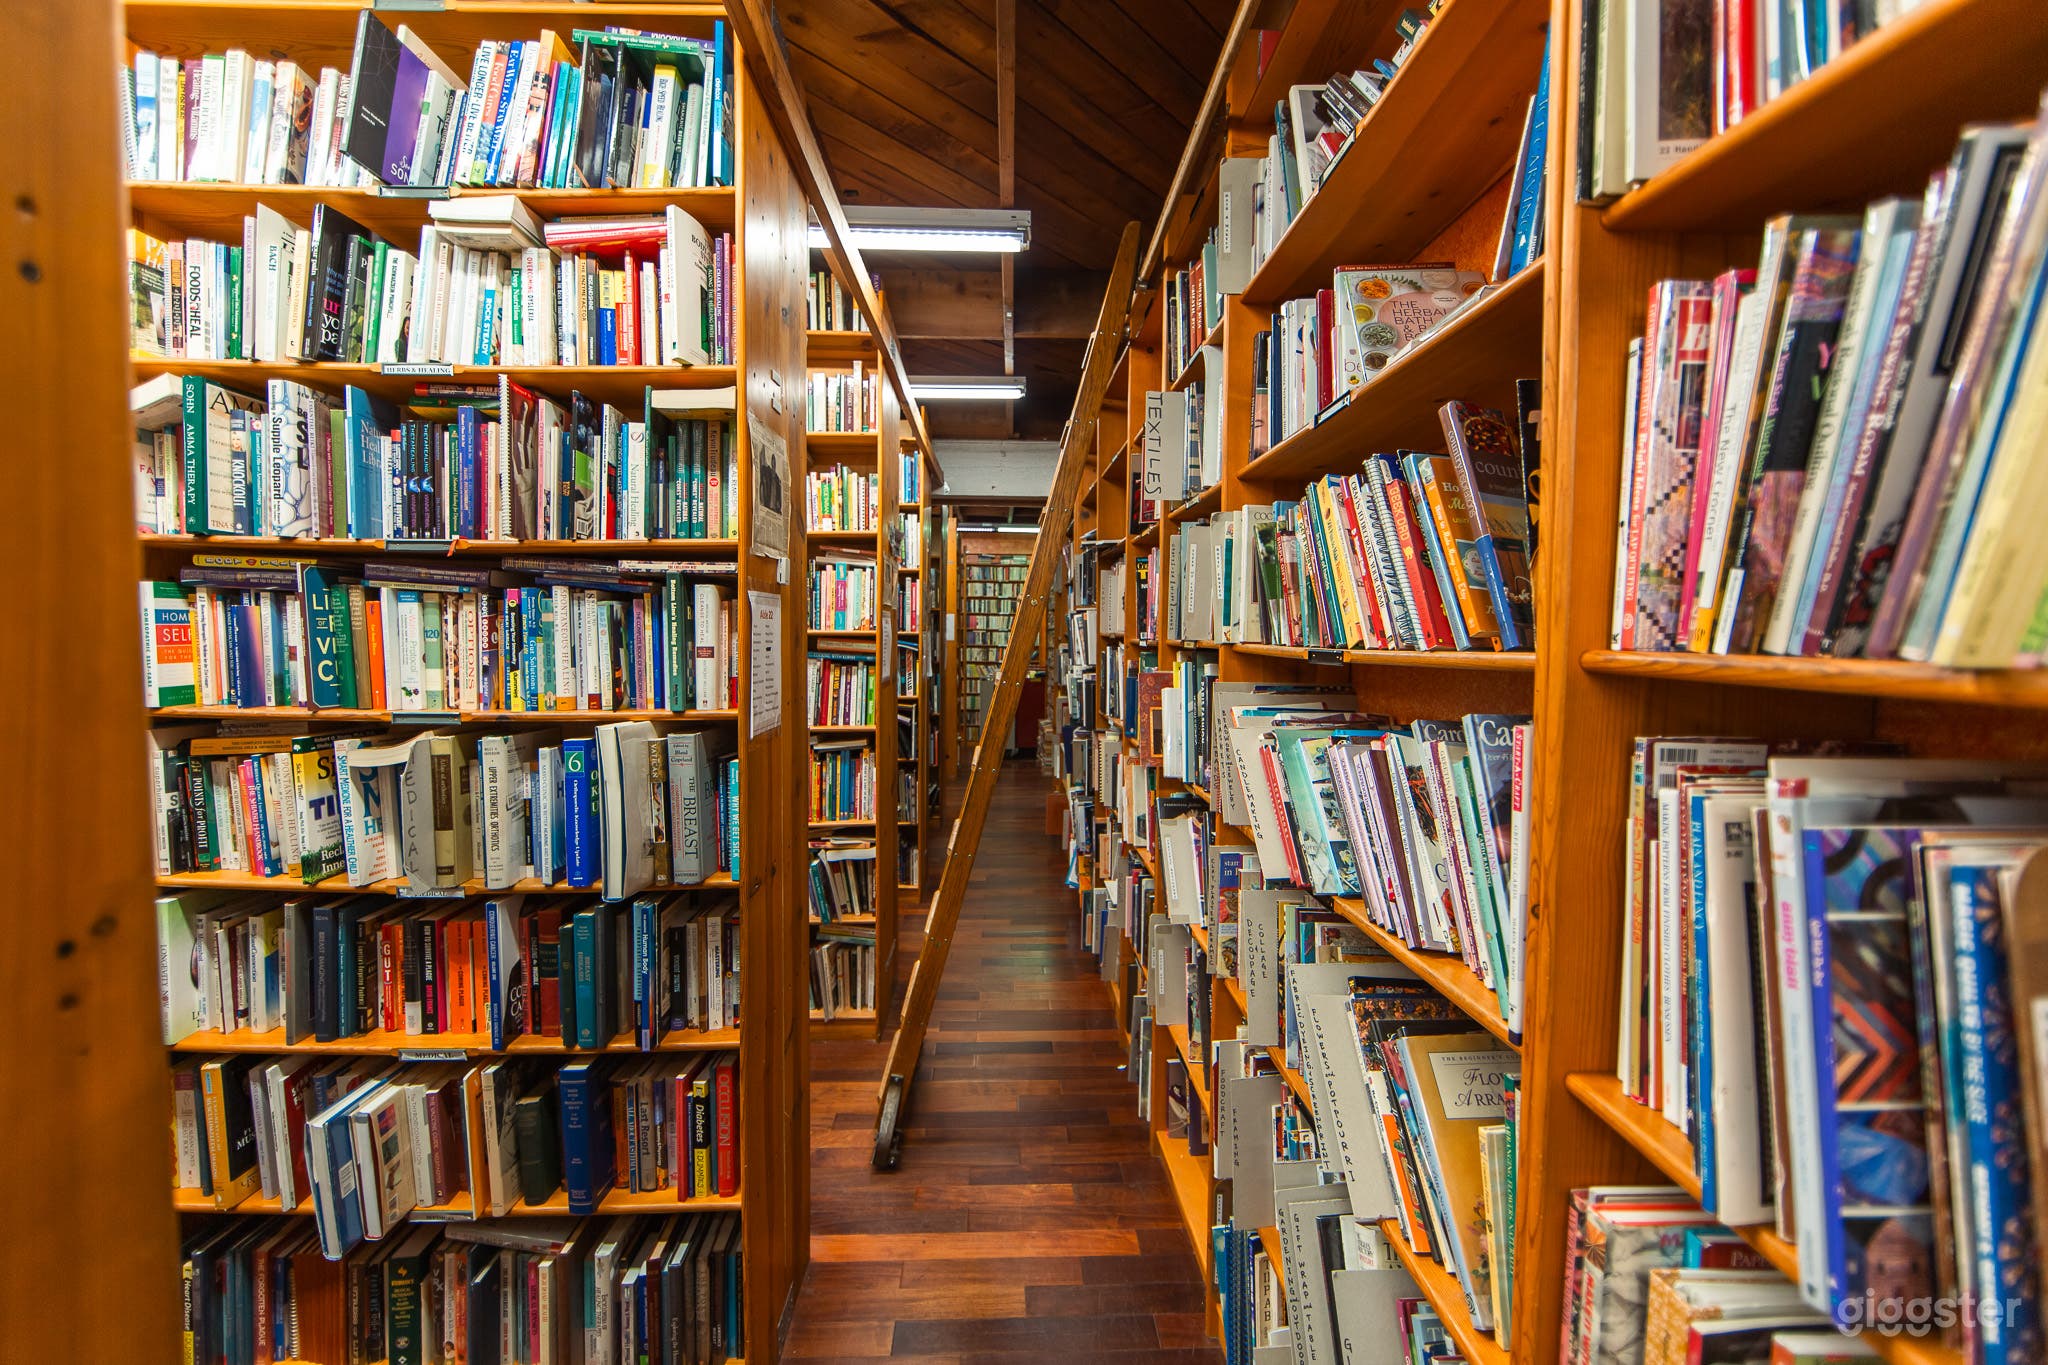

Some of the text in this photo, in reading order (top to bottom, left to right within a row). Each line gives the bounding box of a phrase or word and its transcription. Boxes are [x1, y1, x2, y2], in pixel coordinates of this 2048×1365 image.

[479, 46, 493, 63] LIVE
[472, 65, 489, 99] LONGER
[714, 77, 723, 102] detox
[467, 103, 480, 120] LIVE
[268, 245, 277, 272] BACH
[189, 265, 202, 340] FOODS HEAL
[511, 269, 521, 321] Deep Nutrition
[1391, 300, 1419, 309] THE
[1394, 316, 1434, 326] BATH
[481, 297, 493, 356] ROCK STEADY
[387, 366, 451, 374] HERBS HEALING
[186, 383, 195, 414] SOHN
[187, 423, 196, 505] AMMA THERAPY
[272, 416, 284, 500] Supple Leopard
[1146, 392, 1164, 497] TEXTILES
[1714, 401, 1737, 475] The New
[1852, 411, 1887, 477] ROOM
[230, 459, 247, 508] KNOCKOUT
[629, 463, 640, 528] Natural Healing
[1389, 487, 1410, 541] GEEK DAD
[144, 607, 152, 653] HOMEOPATHIC
[467, 609, 476, 691] OPTIONS
[528, 639, 538, 691] Gut Solutions
[337, 755, 348, 777] SMART
[568, 751, 582, 772] 6
[650, 744, 659, 778] VATICAN
[1512, 726, 1524, 811] START-A-CRAFT
[193, 776, 209, 849] POINTS PROFIT
[340, 777, 351, 806] MEDICINE
[488, 766, 500, 852] UPPER EXTREMITIES ORTHOTICS
[683, 776, 699, 859] THE BREAST
[1235, 748, 1264, 840] CANDLEMAKING
[348, 856, 358, 875] CHILD
[1691, 821, 1704, 858] PLAIN
[641, 933, 650, 976] Human Body
[1246, 918, 1256, 998] DECOUPAGE
[1257, 923, 1268, 979] COLLAGE
[414, 1052, 455, 1060] MEDICAL
[1218, 1069, 1226, 1137] FOODCRAFT
[1311, 1007, 1356, 1183] FLOWERS POTPOURRI
[639, 1101, 651, 1157] Last Resort
[695, 1103, 705, 1144] Diabetes
[1231, 1108, 1241, 1168] FRAMING
[1278, 1208, 1296, 1297] GARDENING
[184, 1277, 192, 1332] Heart Disease
[1294, 1213, 1317, 1361] GIFT WRAP TABLE
